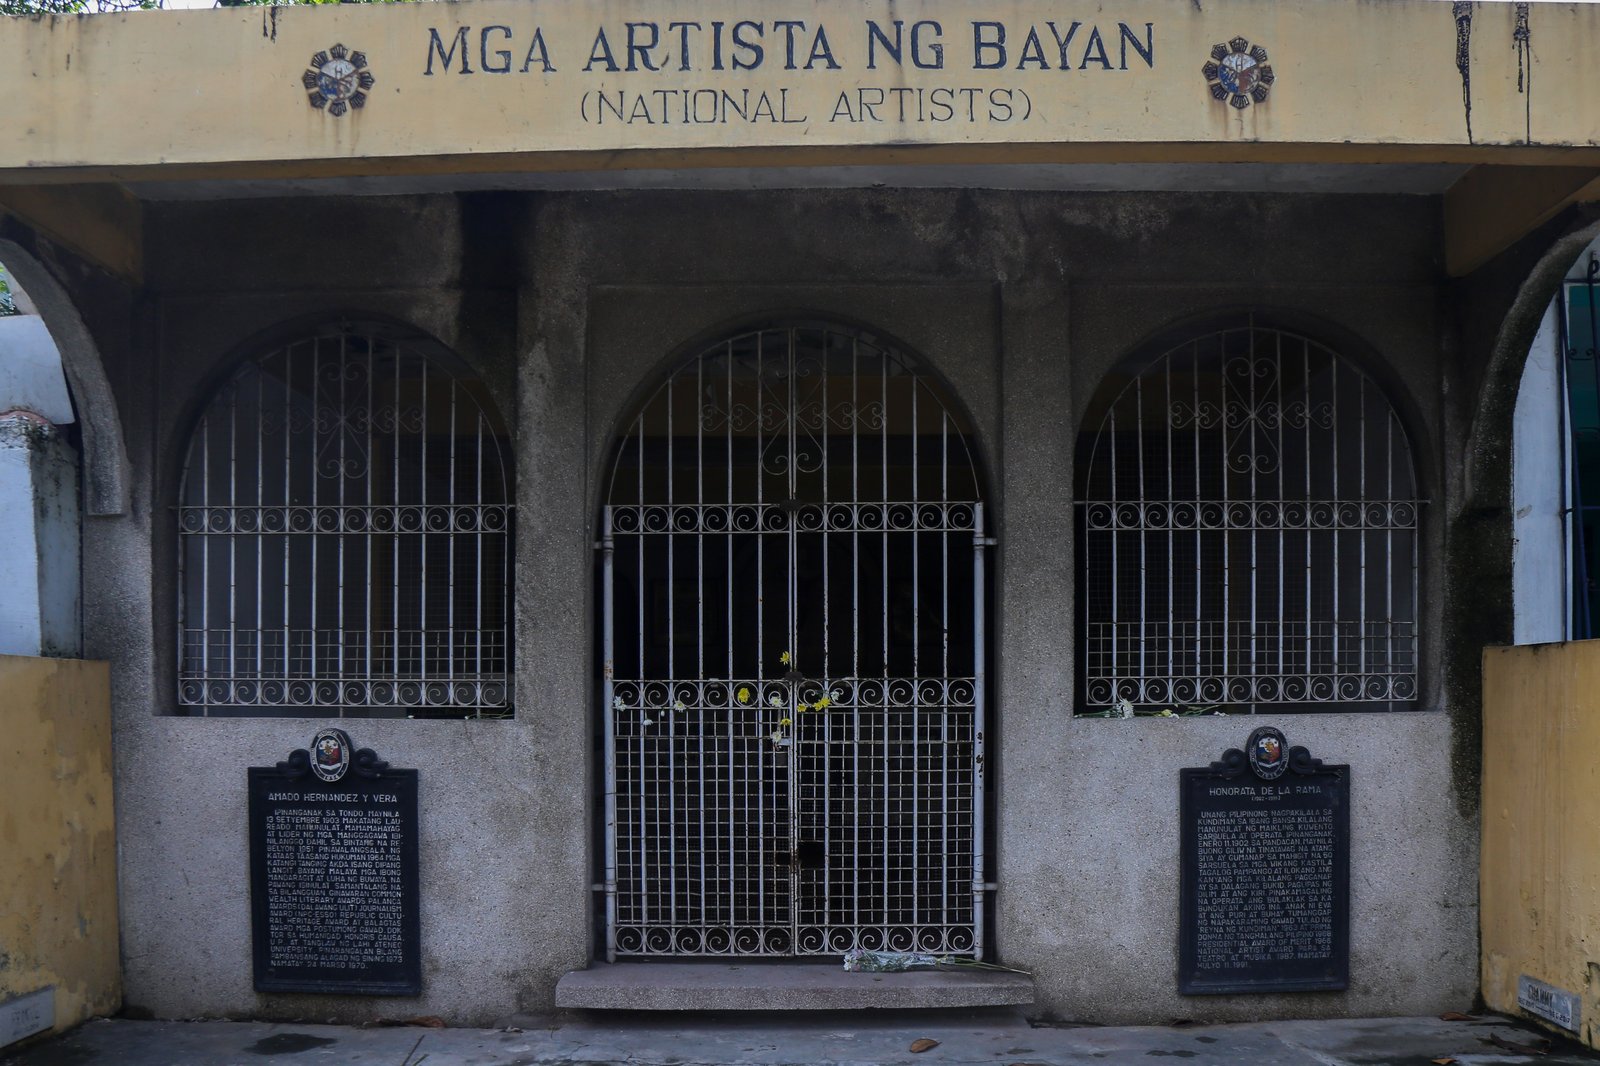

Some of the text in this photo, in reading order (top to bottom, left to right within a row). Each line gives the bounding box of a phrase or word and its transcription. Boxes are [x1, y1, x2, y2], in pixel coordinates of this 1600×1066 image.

[424, 20, 1155, 77] MGA ARTISTA NG BAYAN
[581, 87, 1032, 125] (NATIONAL ARTISTS)
[268, 793, 398, 802] AMADO HERNANDEZ Y VERA
[1210, 786, 1321, 796] HONORATA DE LA RAMA
